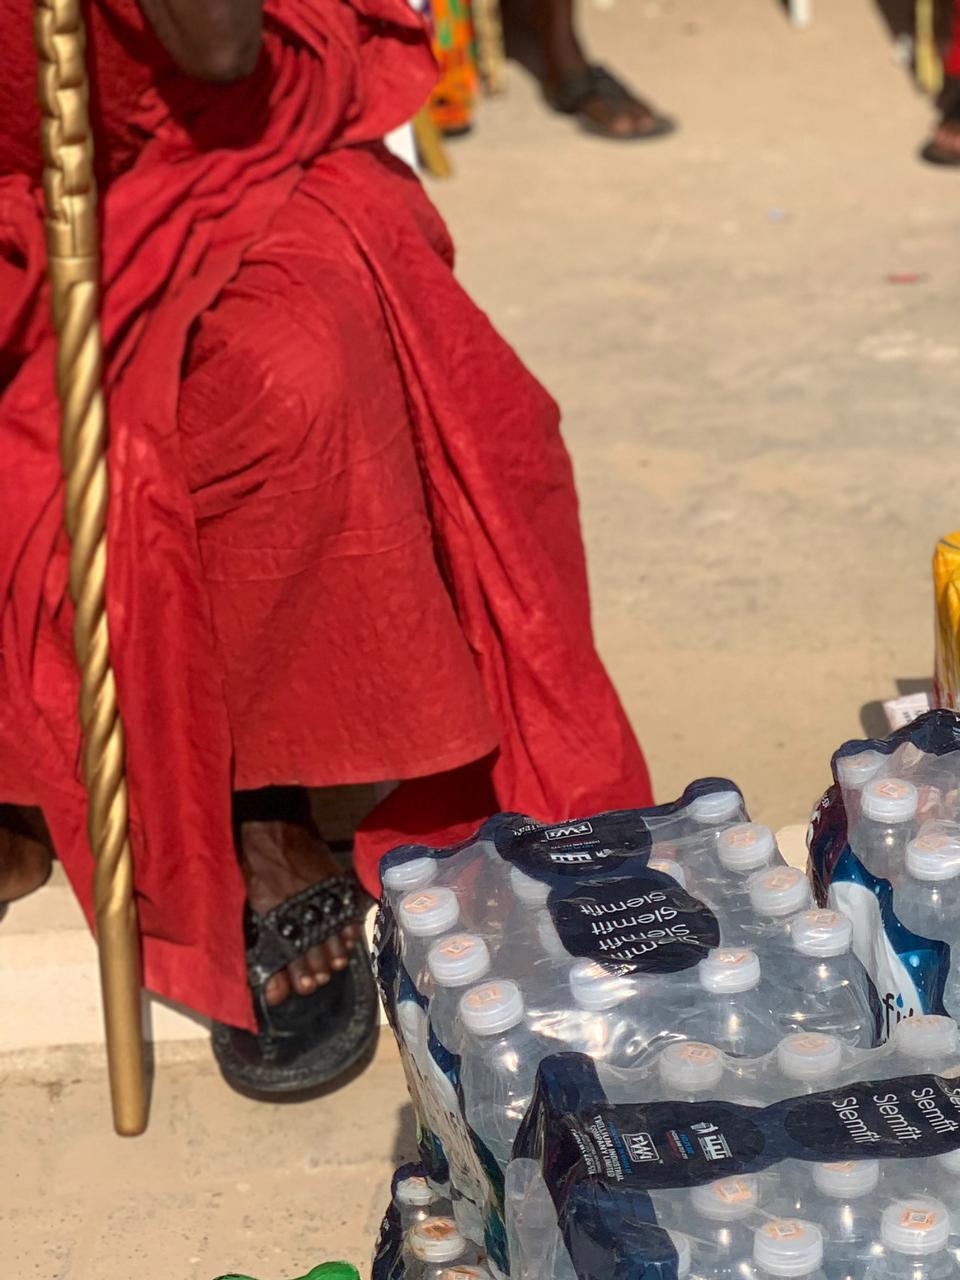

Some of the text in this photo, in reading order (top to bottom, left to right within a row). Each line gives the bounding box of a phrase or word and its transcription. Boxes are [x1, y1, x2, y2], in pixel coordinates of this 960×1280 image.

[580, 892, 667, 917] Slemfit
[592, 906, 678, 936] Slemfit
[599, 924, 690, 951] Slemfit
[832, 1097, 881, 1144] Slemfit
[873, 1093, 923, 1141] Slemfit
[912, 1087, 960, 1135] Slemfit
